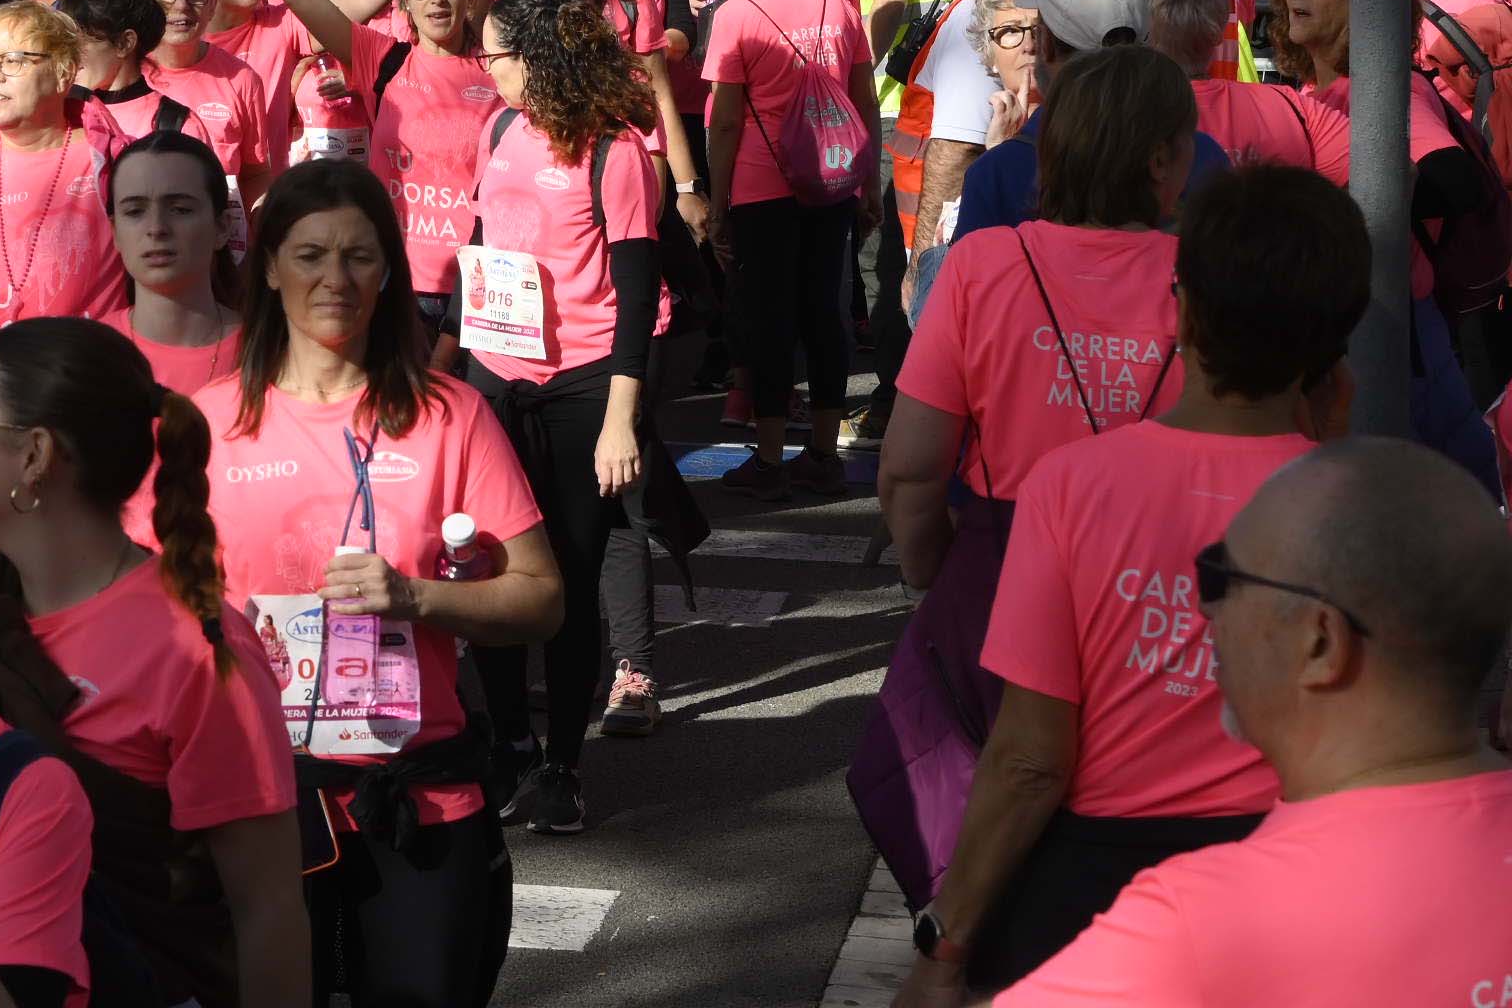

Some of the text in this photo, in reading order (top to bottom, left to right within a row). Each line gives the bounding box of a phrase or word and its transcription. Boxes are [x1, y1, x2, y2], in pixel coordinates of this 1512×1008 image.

[384, 148, 413, 172] TU
[488, 289, 513, 307] 016
[1033, 325, 1163, 363] CARRERA
[1057, 355, 1137, 387] DE LA
[1083, 414, 1107, 426] 223
[226, 459, 298, 484] OYSHO
[1141, 606, 1193, 644] DE
[1164, 681, 1199, 696] 2023
[325, 708, 339, 717] LA
[354, 730, 408, 741] Santander
